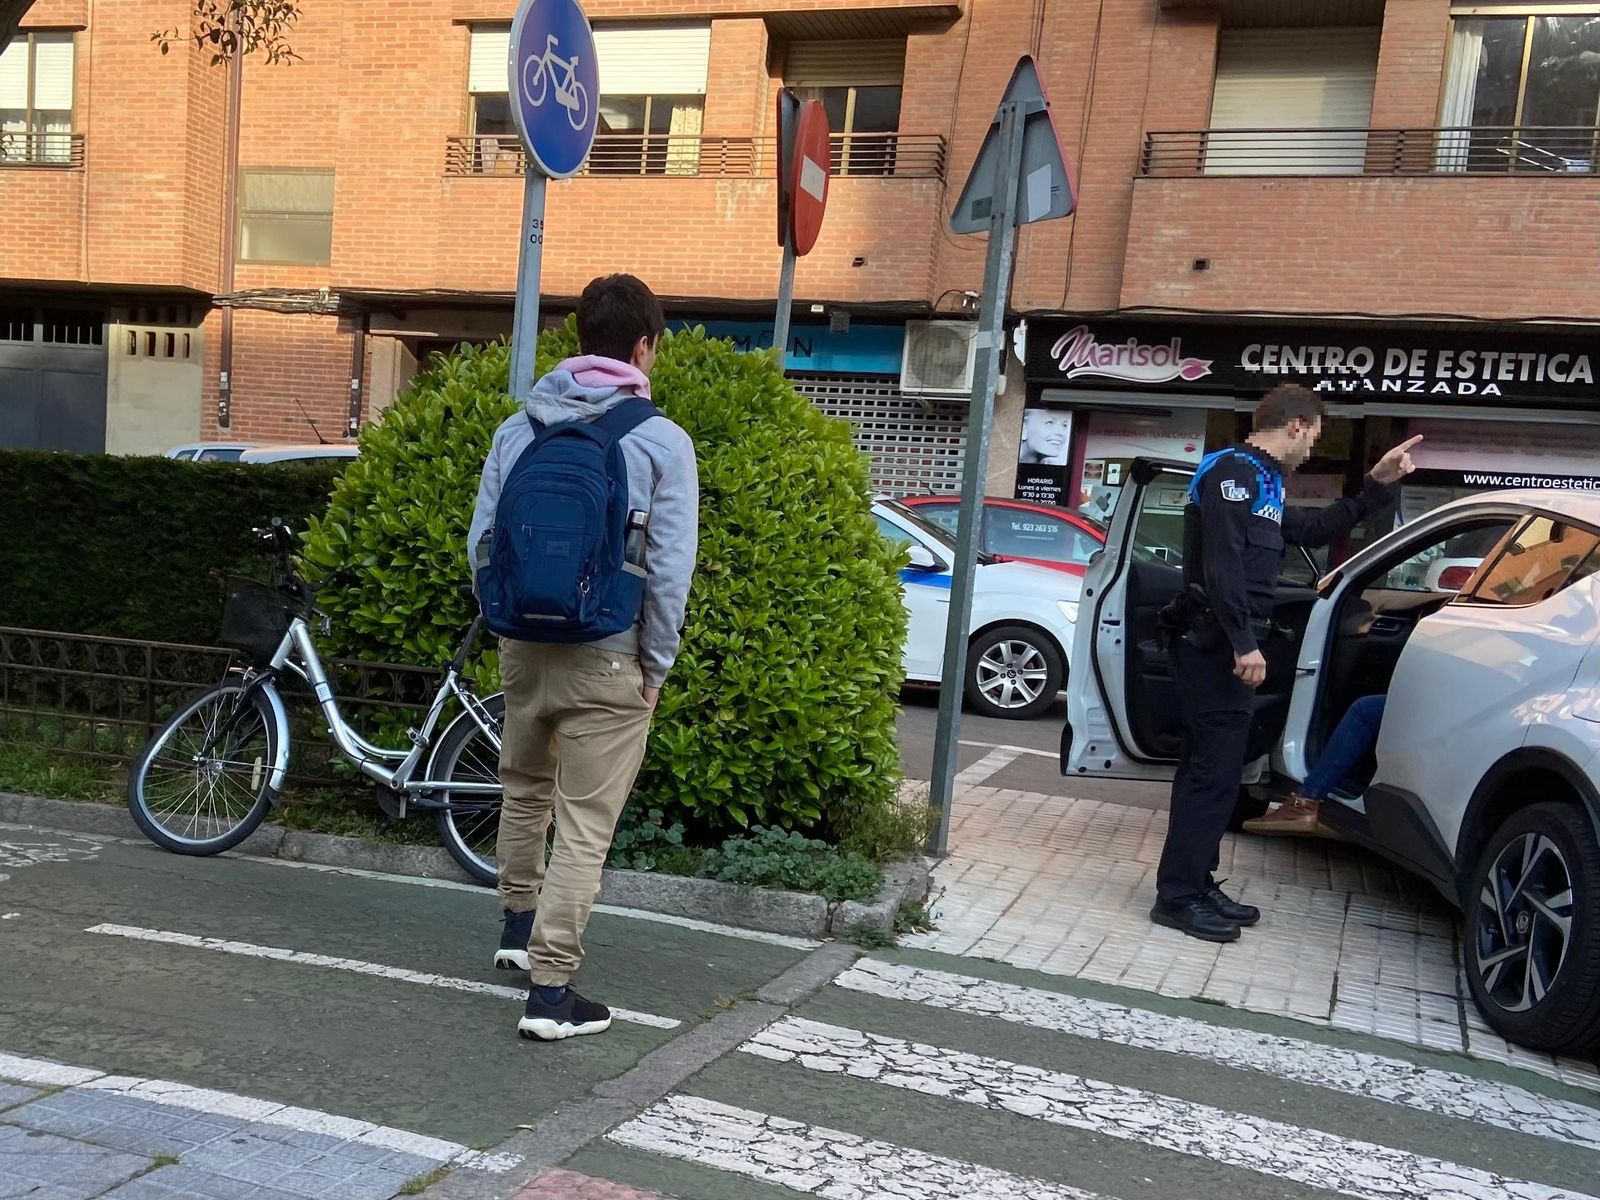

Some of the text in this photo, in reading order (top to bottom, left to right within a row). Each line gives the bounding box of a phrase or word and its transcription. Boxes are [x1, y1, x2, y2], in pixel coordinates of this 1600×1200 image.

[1051, 325, 1182, 371] Marisol
[1241, 344, 1594, 384] CENTRO DE ESTETICA
[1463, 474, 1600, 490] www.centroestetic
[1011, 522, 1021, 530] Tel.
[1022, 523, 1034, 531] 923
